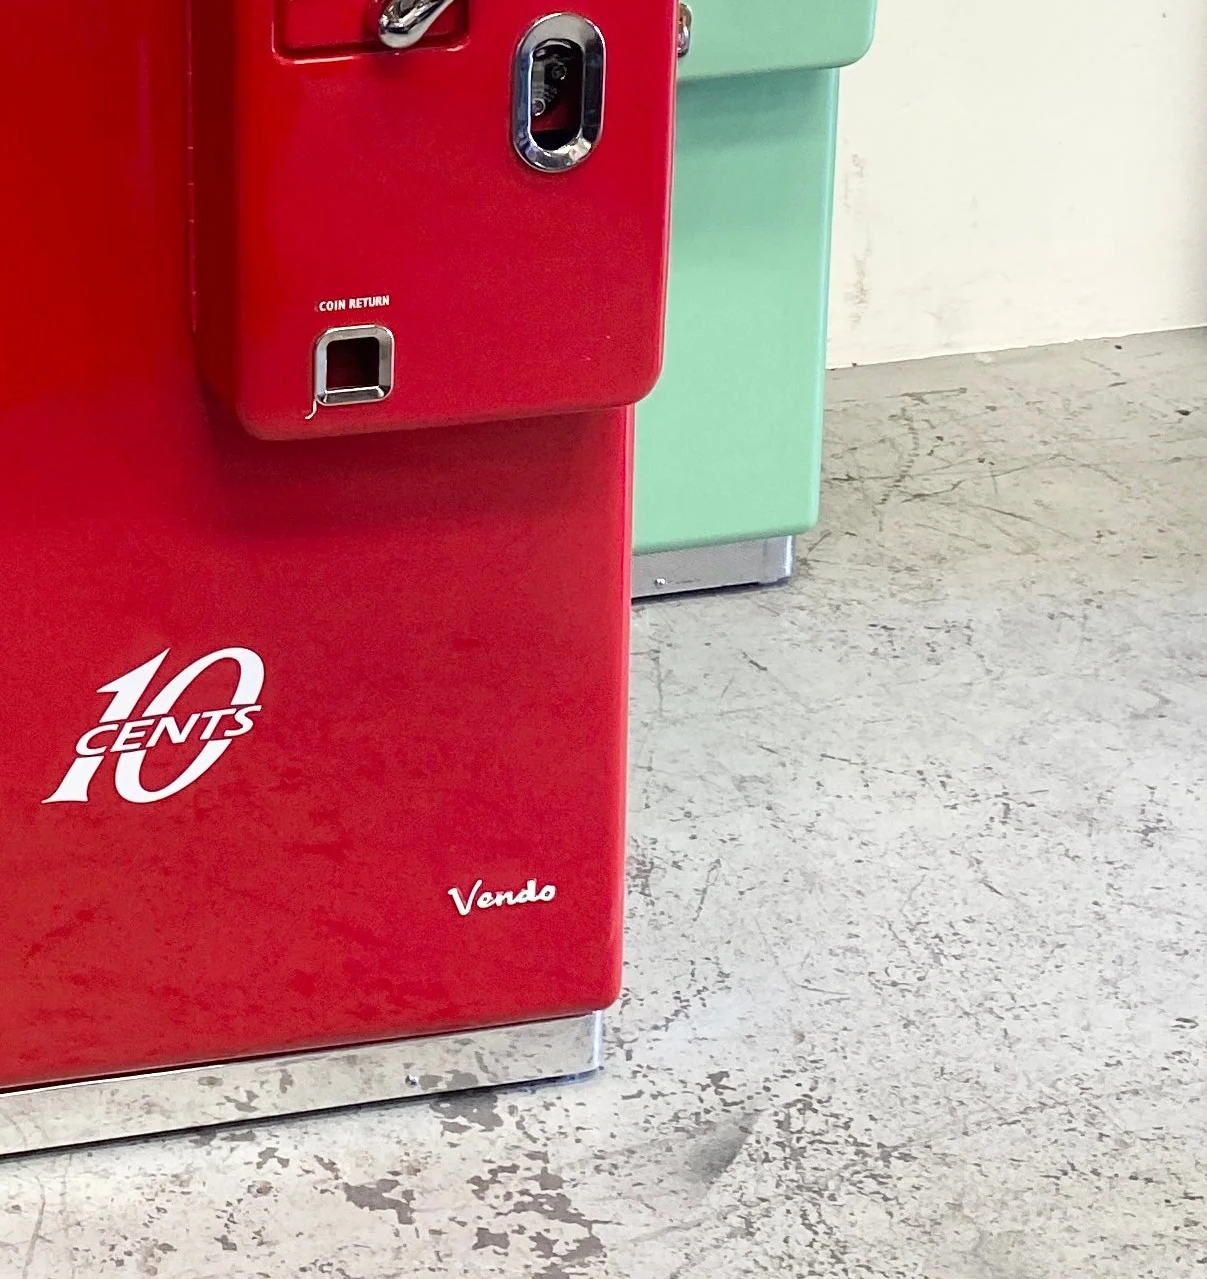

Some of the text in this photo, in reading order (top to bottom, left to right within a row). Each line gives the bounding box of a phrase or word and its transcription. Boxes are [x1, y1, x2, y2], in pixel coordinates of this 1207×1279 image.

[319, 295, 390, 311] COIN RETURN
[42, 647, 265, 804] 10
[75, 705, 262, 757] CENTS
[448, 878, 556, 916] Vendo
